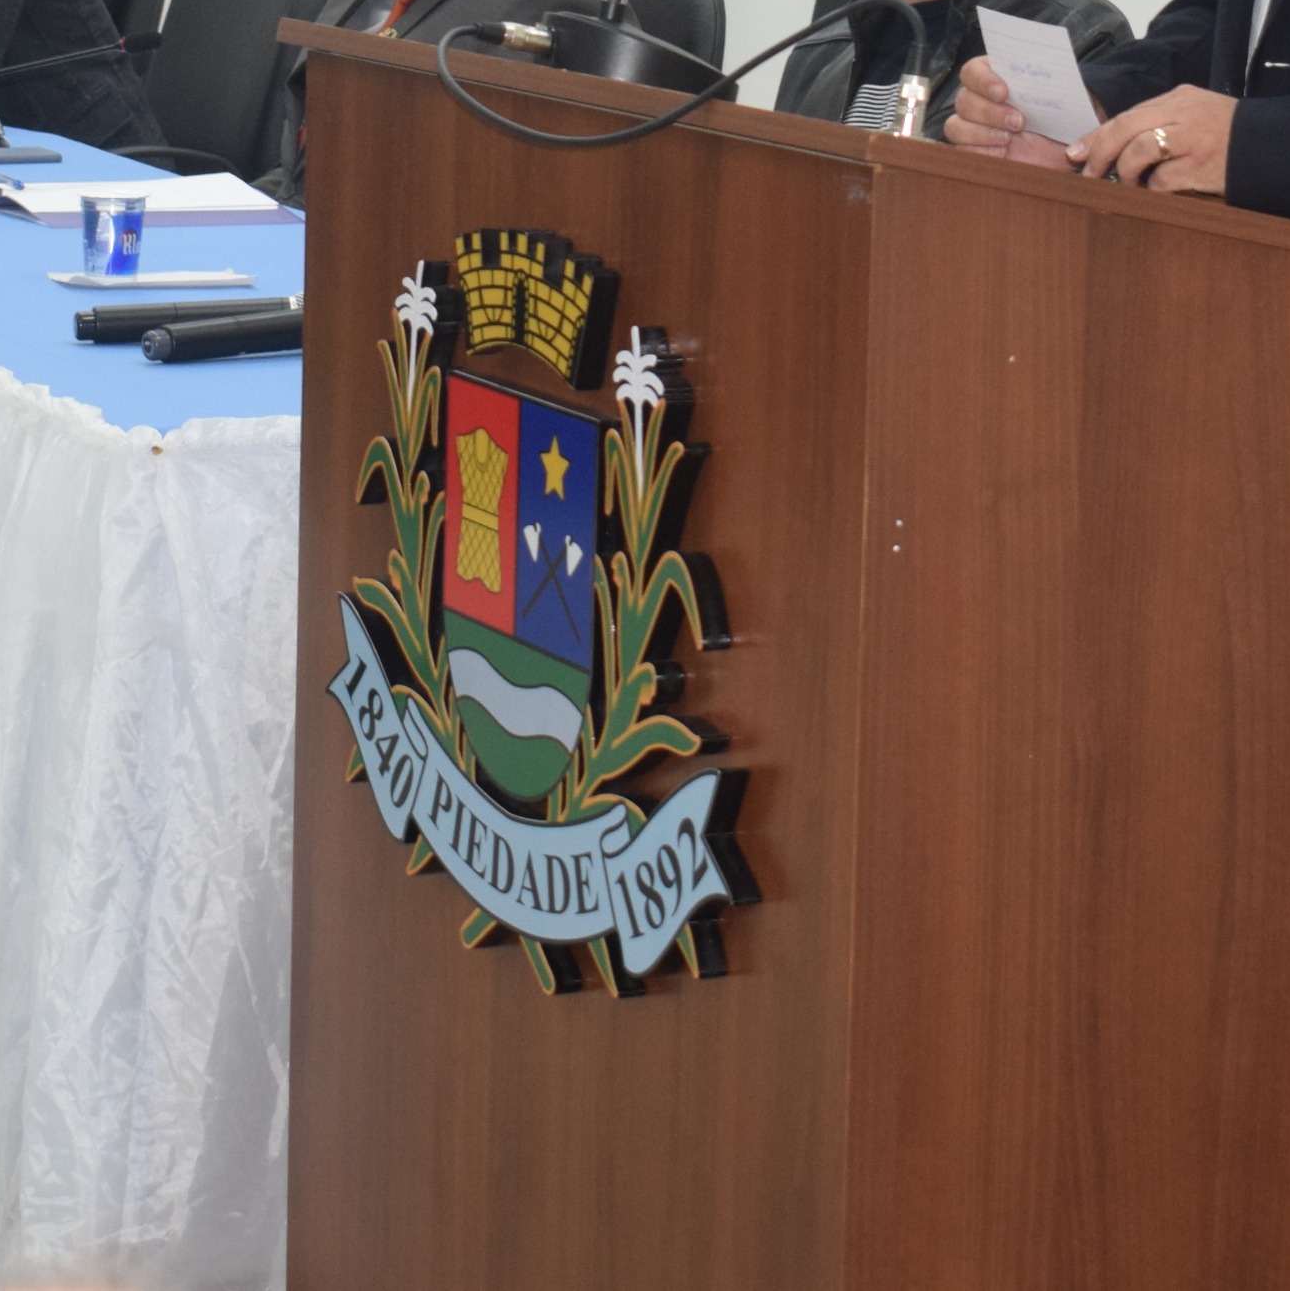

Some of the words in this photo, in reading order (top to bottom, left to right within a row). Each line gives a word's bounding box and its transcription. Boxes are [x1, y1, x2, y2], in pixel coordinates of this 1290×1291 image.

[344, 654, 414, 808] 1840
[428, 769, 599, 915] PIEDADE
[615, 817, 708, 939] 1892
